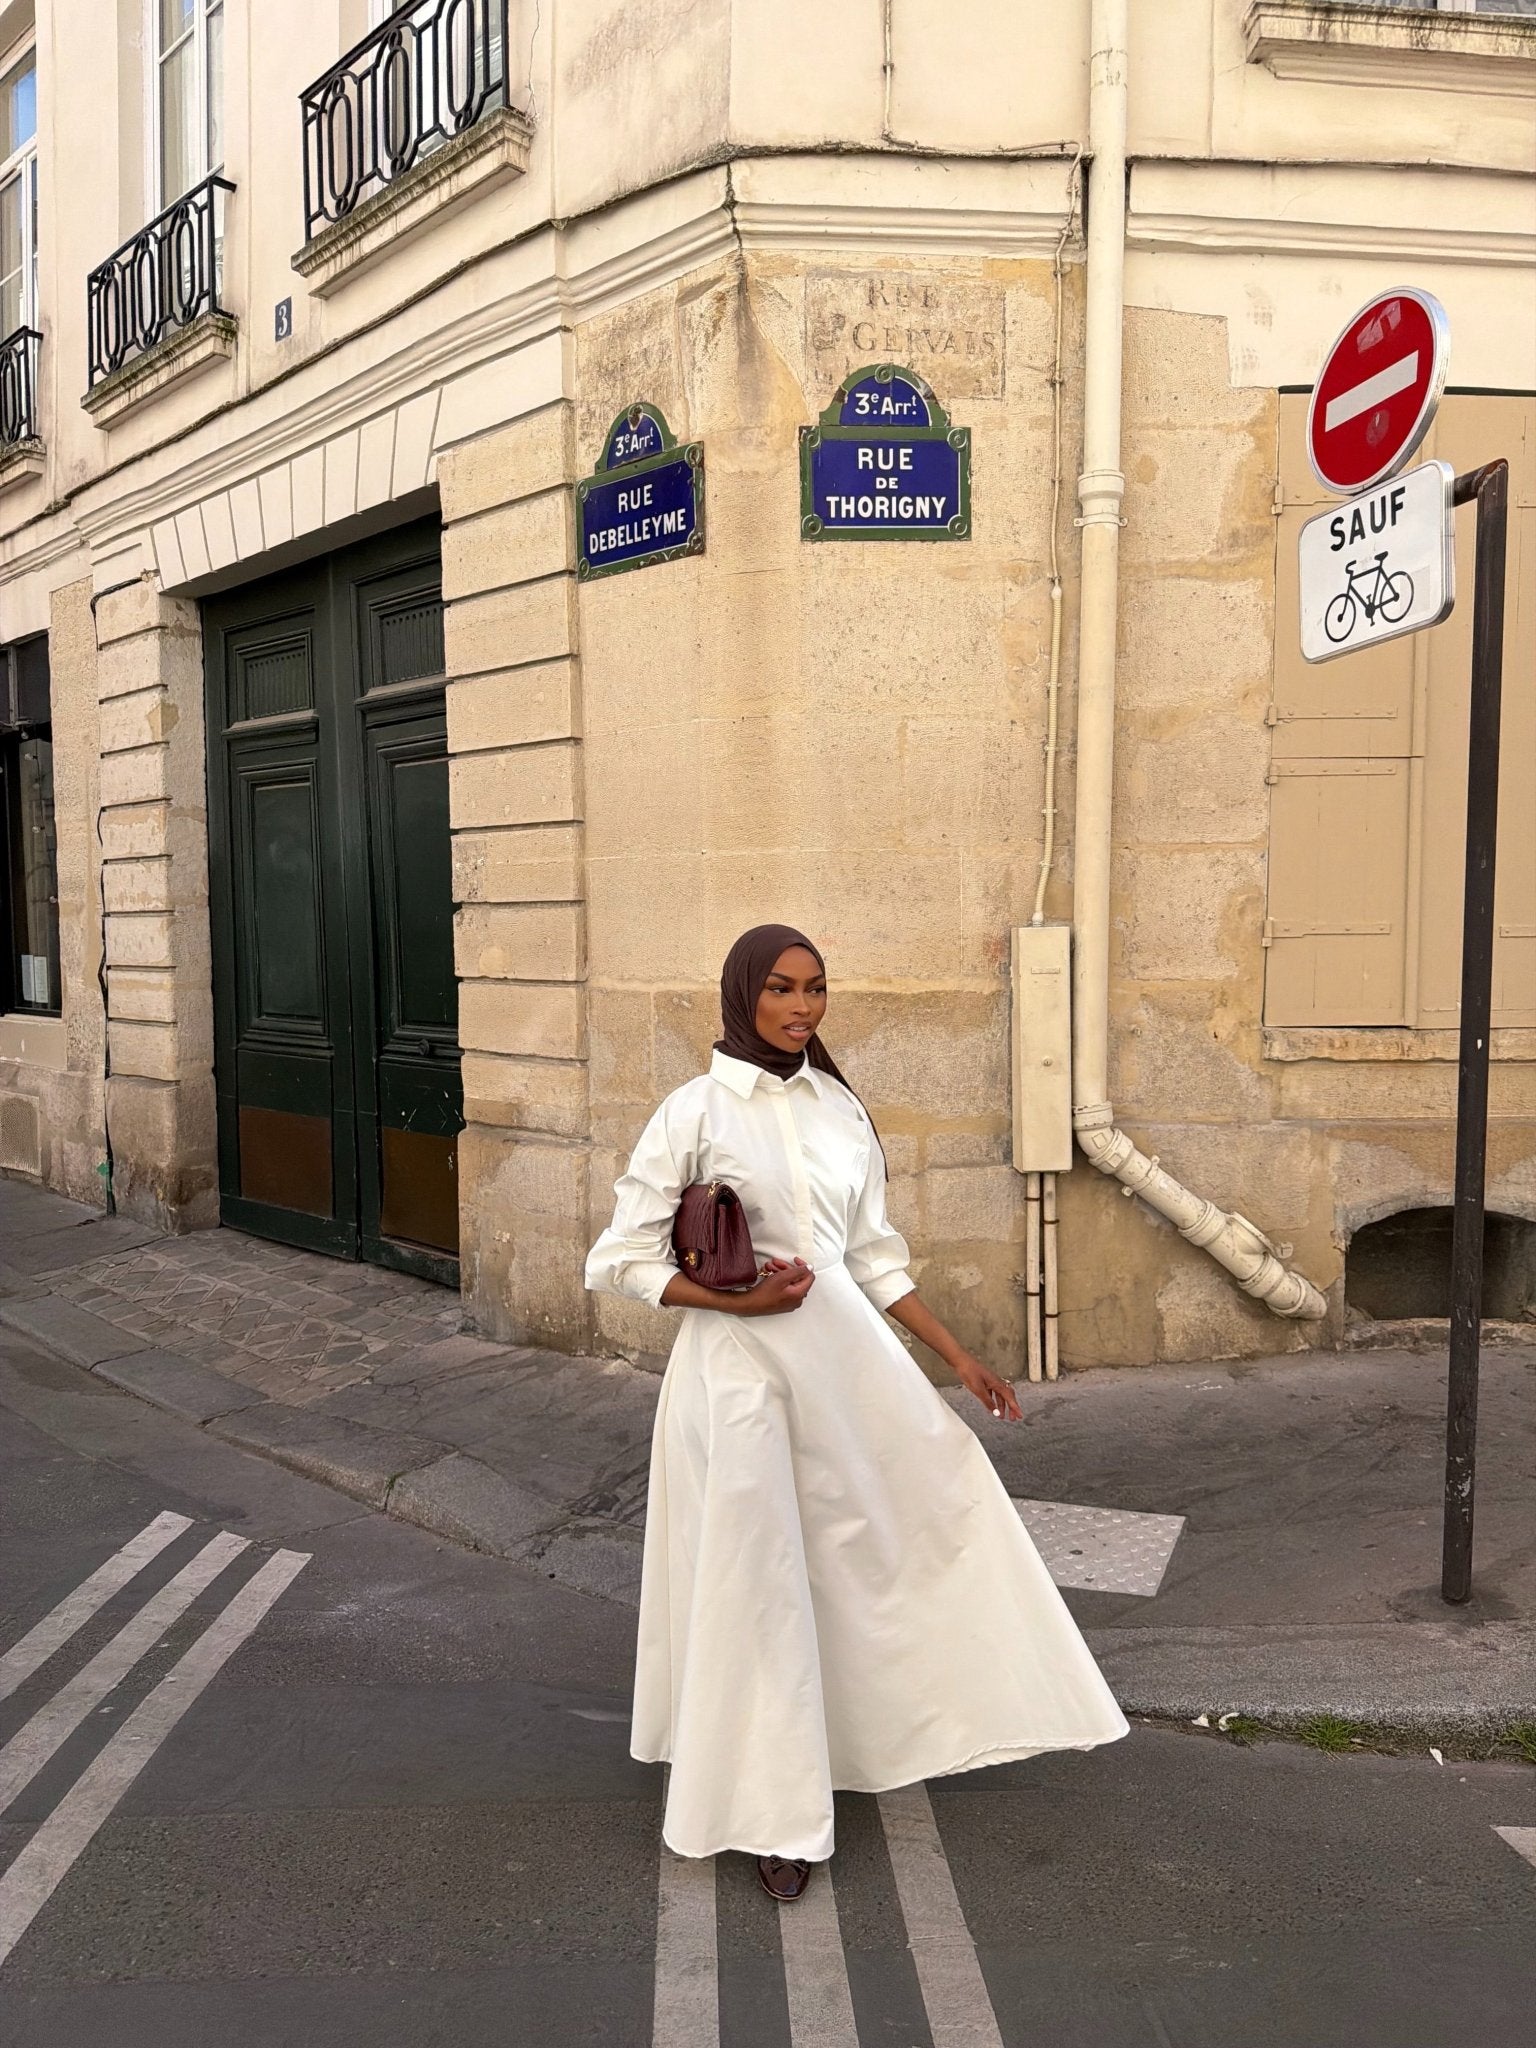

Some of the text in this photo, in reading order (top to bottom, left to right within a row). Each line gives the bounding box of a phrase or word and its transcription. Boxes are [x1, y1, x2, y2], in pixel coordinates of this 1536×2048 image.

[278, 304, 288, 336] 3
[858, 447, 914, 470] RUE
[618, 483, 653, 514] RUE
[875, 477, 899, 490] DE
[825, 496, 947, 519] THORIGNY
[1329, 485, 1407, 552] SAUF
[589, 508, 687, 555] DEBELLEYME
